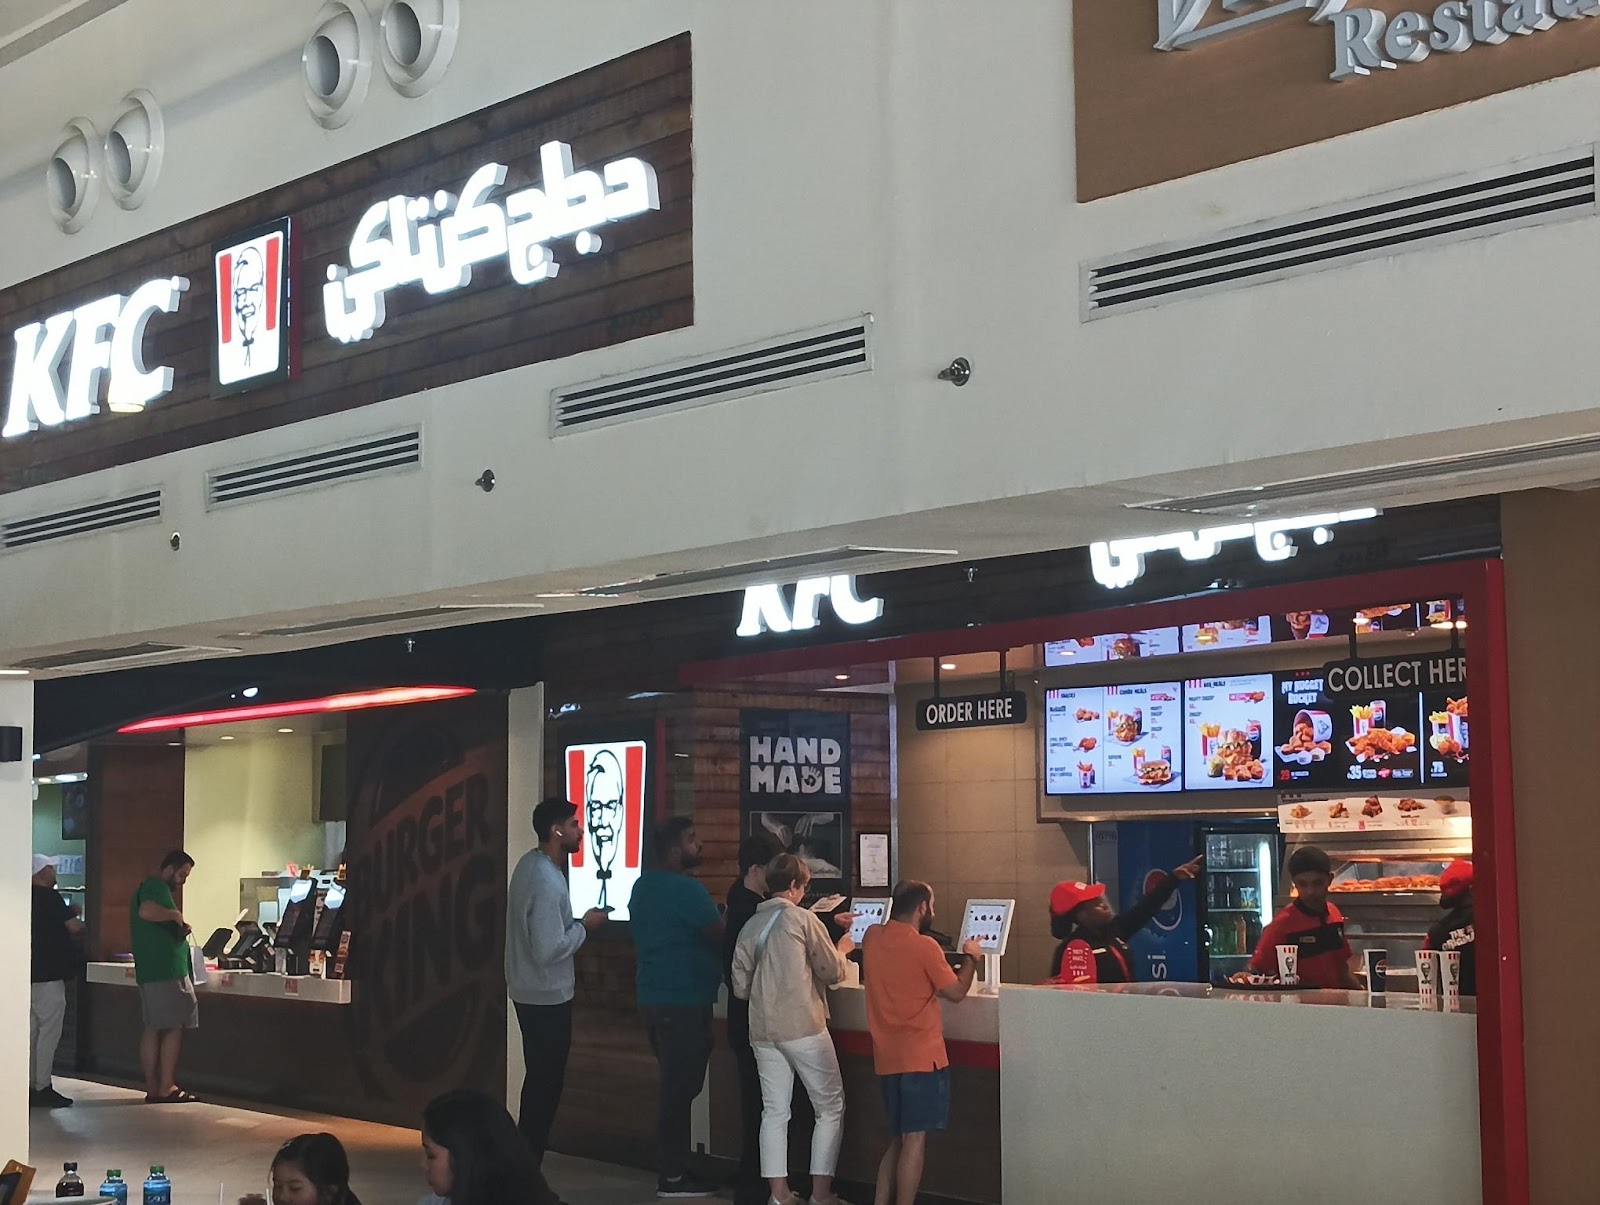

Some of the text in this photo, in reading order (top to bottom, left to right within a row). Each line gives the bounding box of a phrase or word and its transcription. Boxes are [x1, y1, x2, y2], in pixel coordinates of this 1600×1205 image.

[2, 275, 190, 438] KFC
[1328, 661, 1422, 692] COLLECT
[926, 697, 1012, 724] ORDER HERE
[750, 736, 841, 765] HAND
[750, 765, 842, 794] MADE
[353, 772, 491, 925] BURGER
[1147, 954, 1167, 979] si
